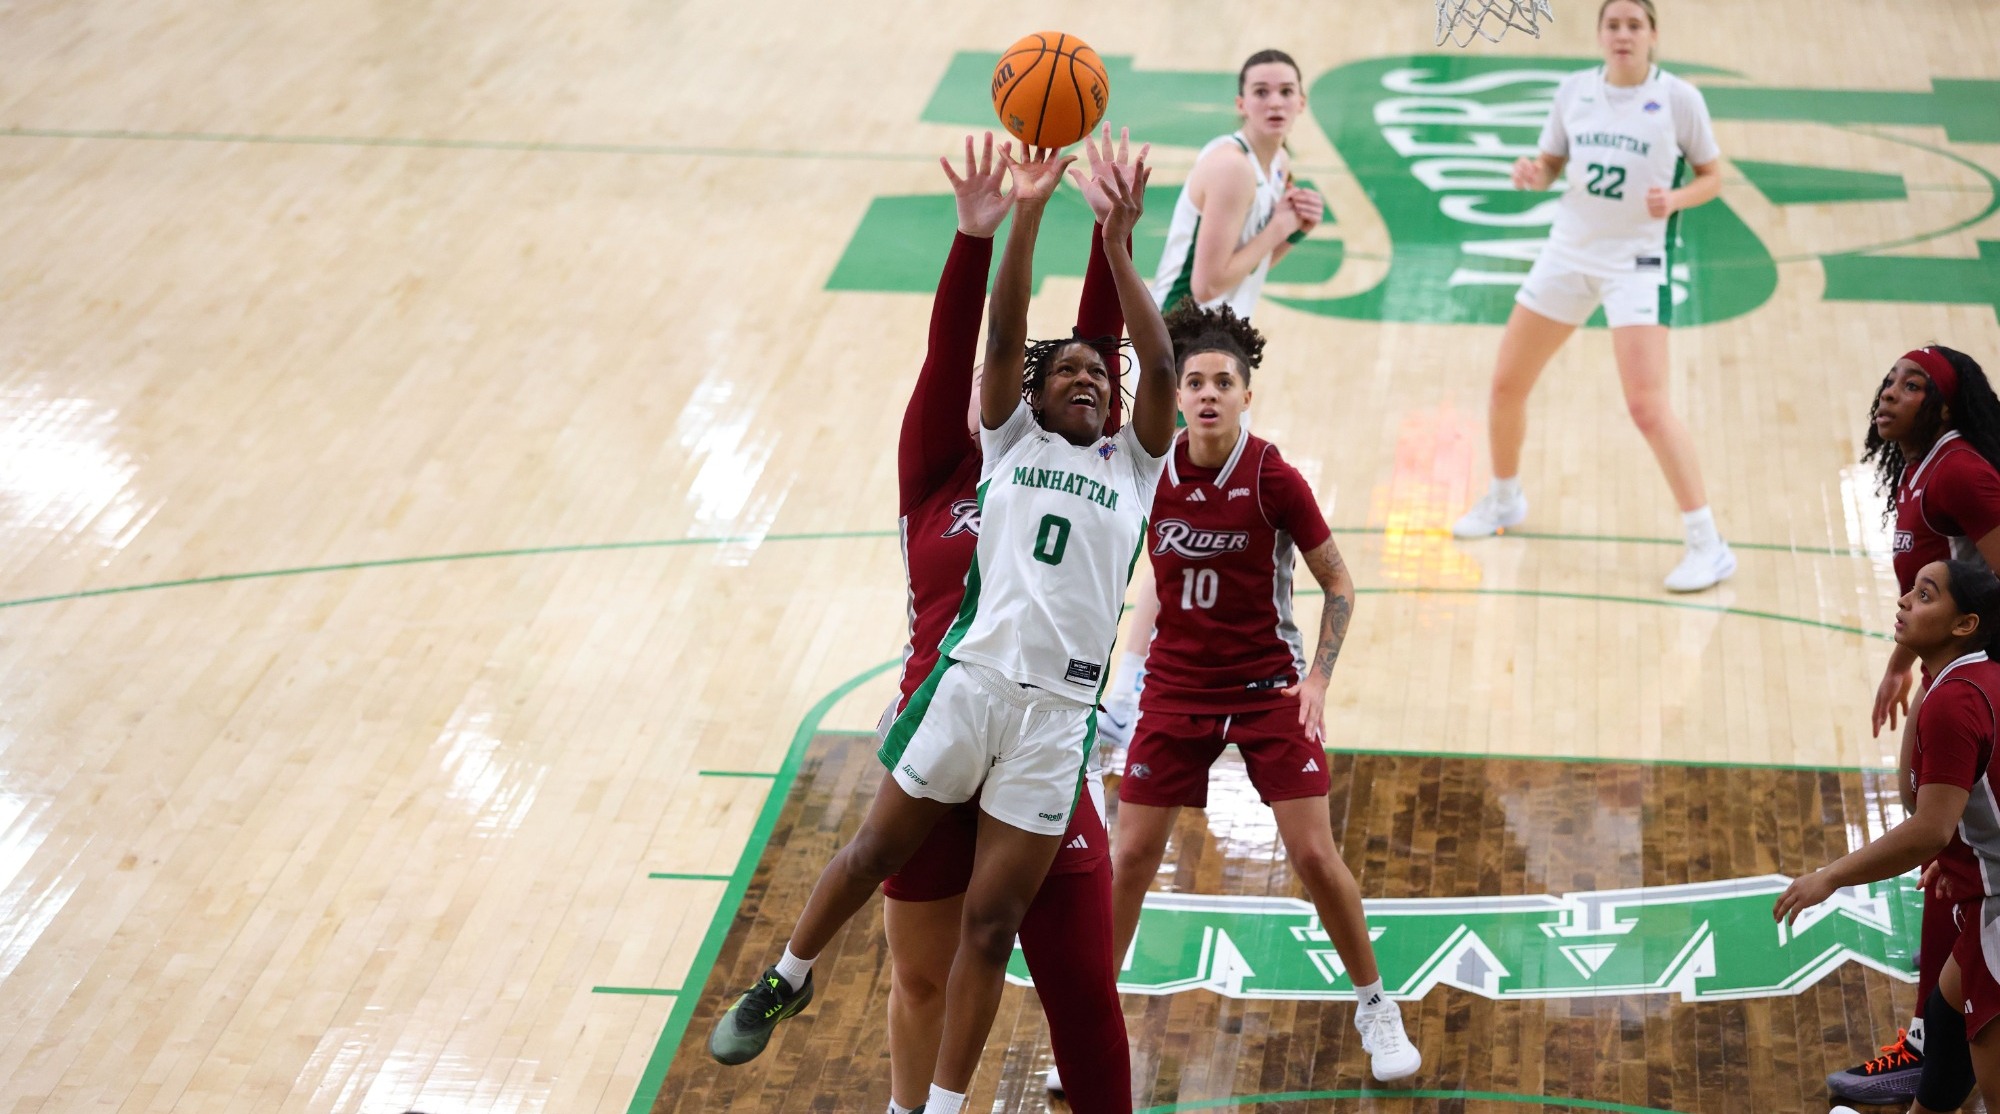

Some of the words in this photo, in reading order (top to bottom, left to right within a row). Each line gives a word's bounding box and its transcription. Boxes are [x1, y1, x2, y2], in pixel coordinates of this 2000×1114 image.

[1575, 132, 1650, 156] MANHATTAN
[1587, 163, 1626, 200] 22
[1012, 466, 1119, 511] MANHATTAN
[1032, 513, 1072, 567] 0
[1181, 568, 1219, 610] 10
